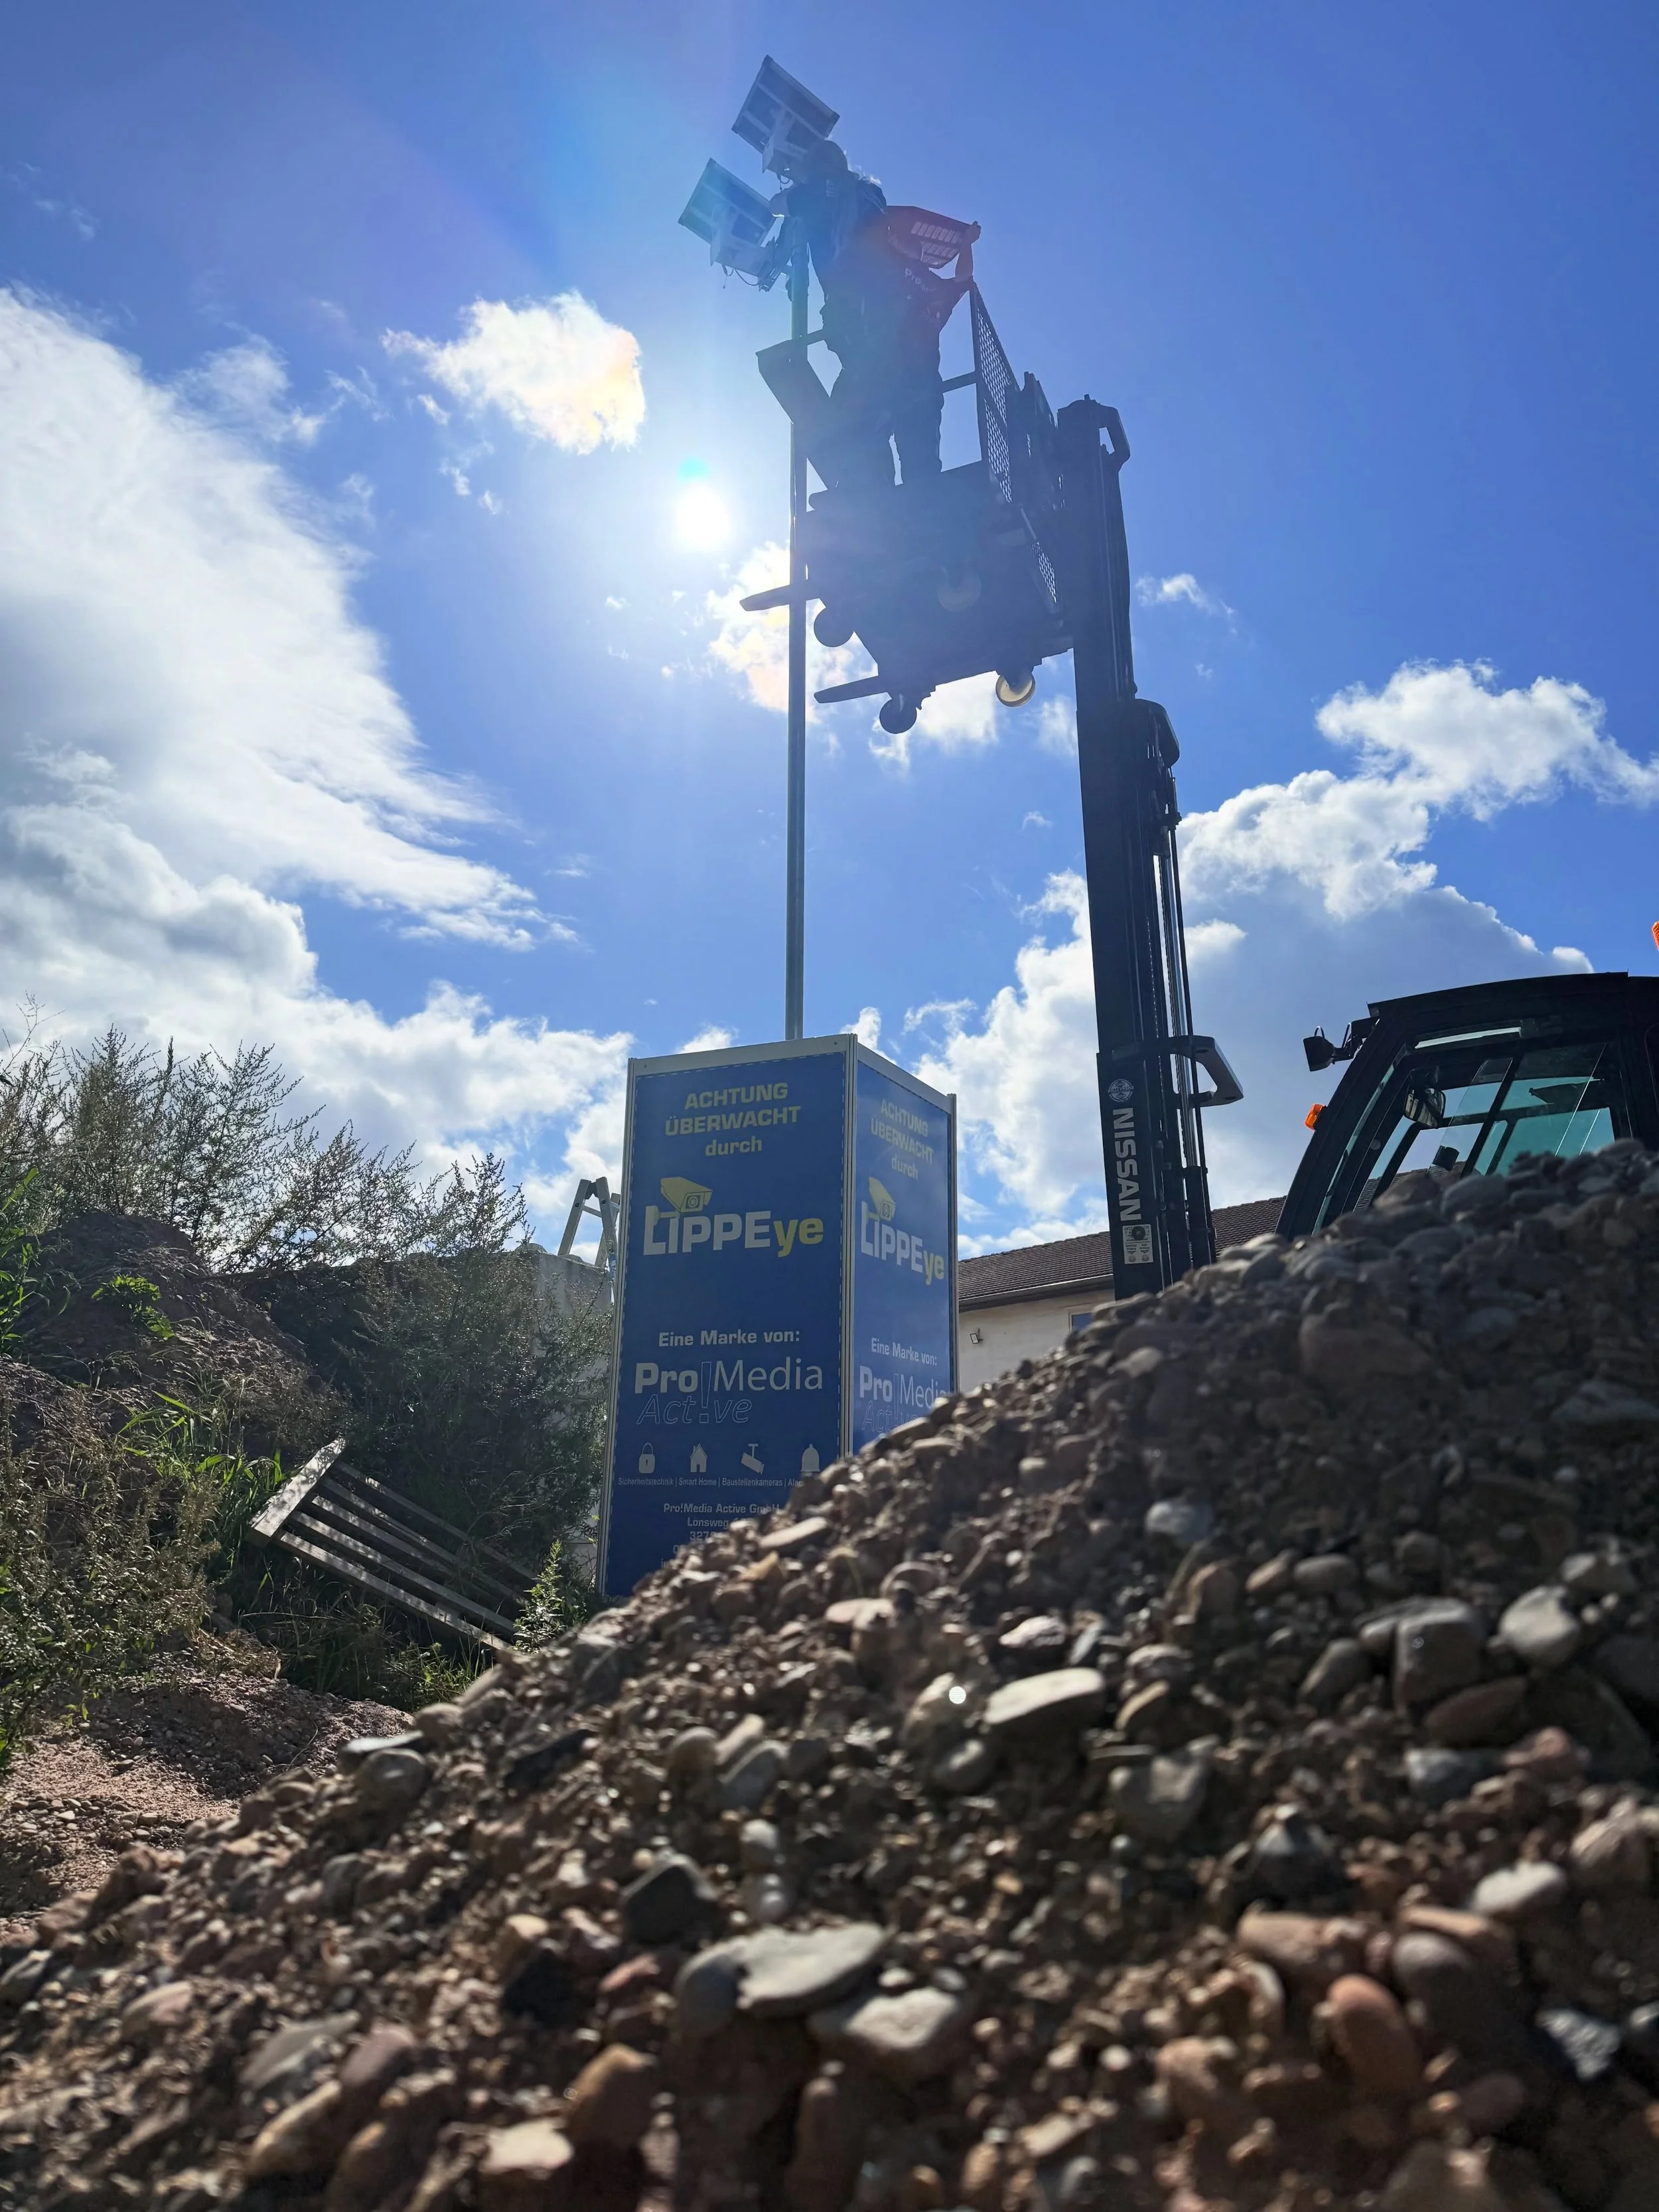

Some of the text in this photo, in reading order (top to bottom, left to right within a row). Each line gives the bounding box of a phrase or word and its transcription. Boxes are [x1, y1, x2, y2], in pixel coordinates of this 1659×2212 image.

[684, 1082, 788, 1110] ACHTUNG
[665, 1106, 801, 1136] ÜBERWACHT
[881, 1098, 928, 1137] ACHTUNG
[705, 1136, 762, 1157] durch
[871, 1114, 934, 1165] ÜBERWACHT
[891, 1153, 918, 1180] durch
[1112, 1107, 1142, 1222] NISSAN
[658, 1329, 800, 1347] Eine Marke von:
[871, 1337, 938, 1366] Eine Marke von:
[618, 1477, 674, 1486] Sicherheitstechnik
[679, 1477, 698, 1487] Smart
[698, 1478, 717, 1487] Home
[722, 1478, 783, 1487] Baustellenkameras
[664, 1503, 712, 1514] Pro!Media
[716, 1503, 747, 1514] Active
